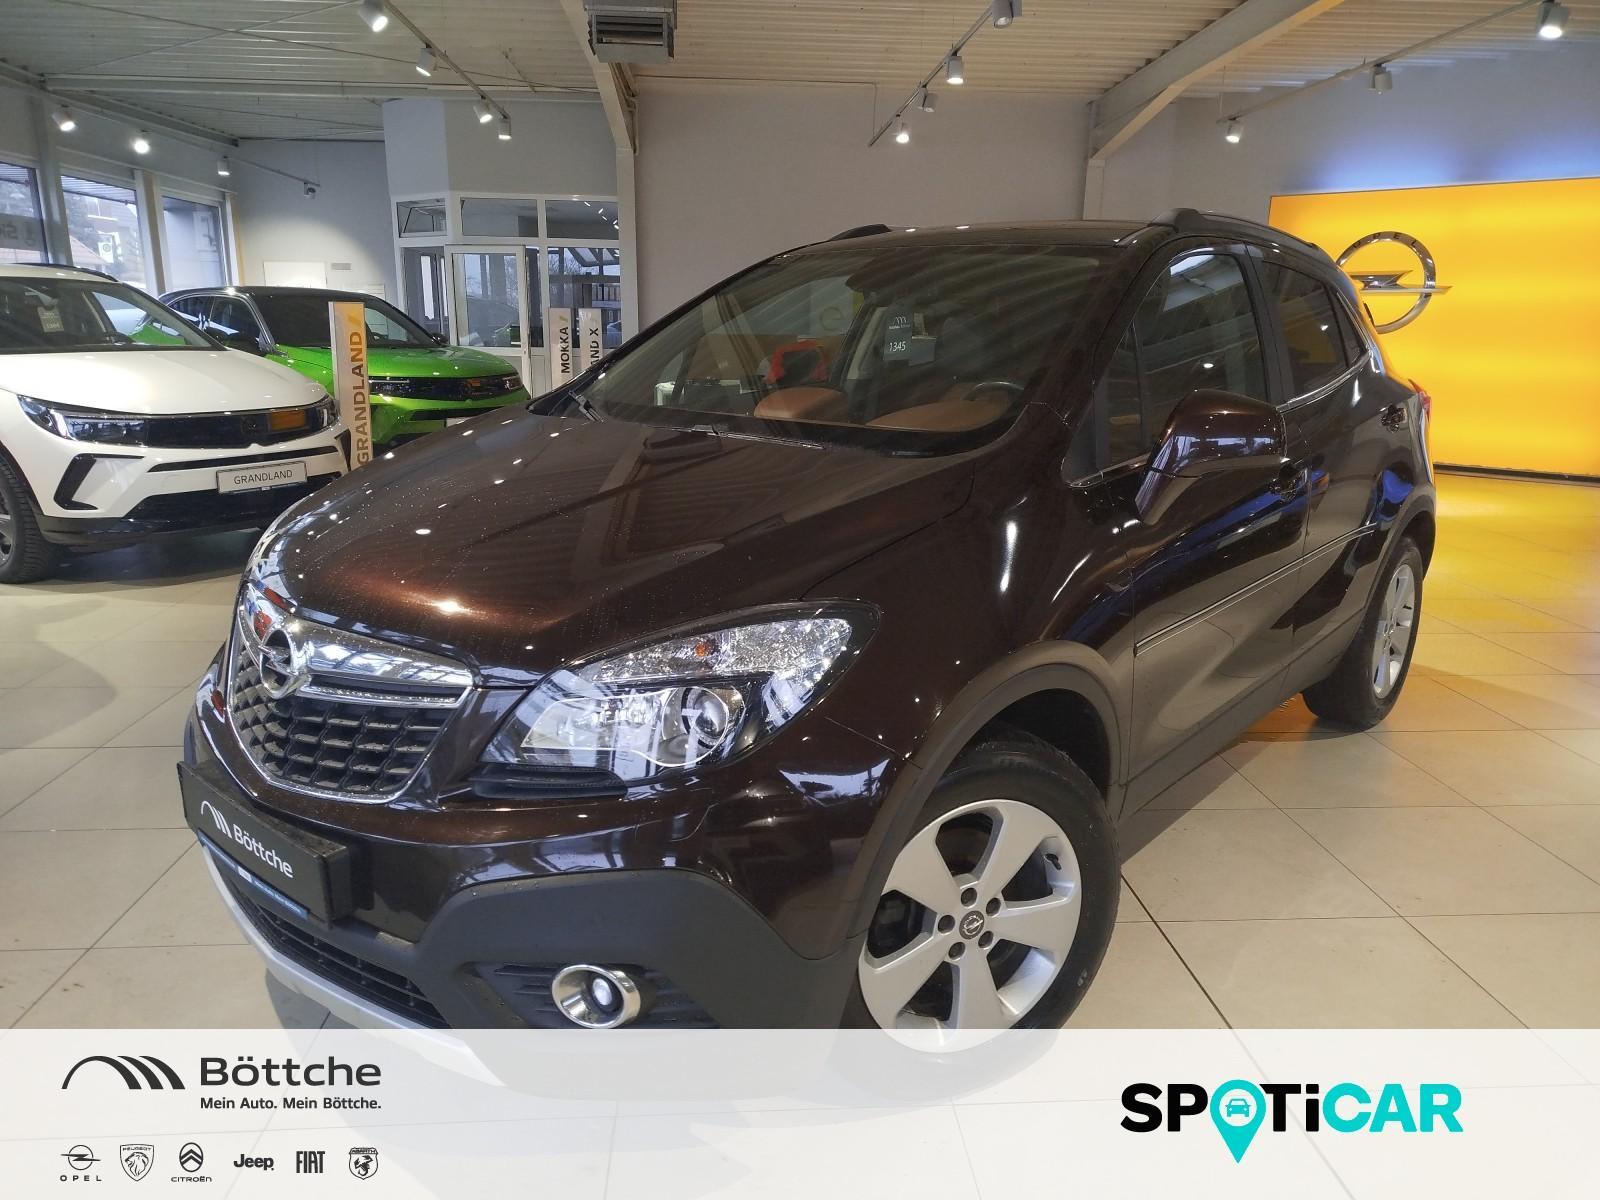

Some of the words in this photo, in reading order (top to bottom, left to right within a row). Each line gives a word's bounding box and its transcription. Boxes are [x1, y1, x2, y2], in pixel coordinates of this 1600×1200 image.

[589, 327, 599, 337] X
[889, 341, 906, 351] 1345
[560, 327, 570, 374] MOKKA
[350, 331, 369, 465] GRANDLAND
[233, 469, 293, 485] GRANDLAND
[233, 823, 294, 879] Böttche
